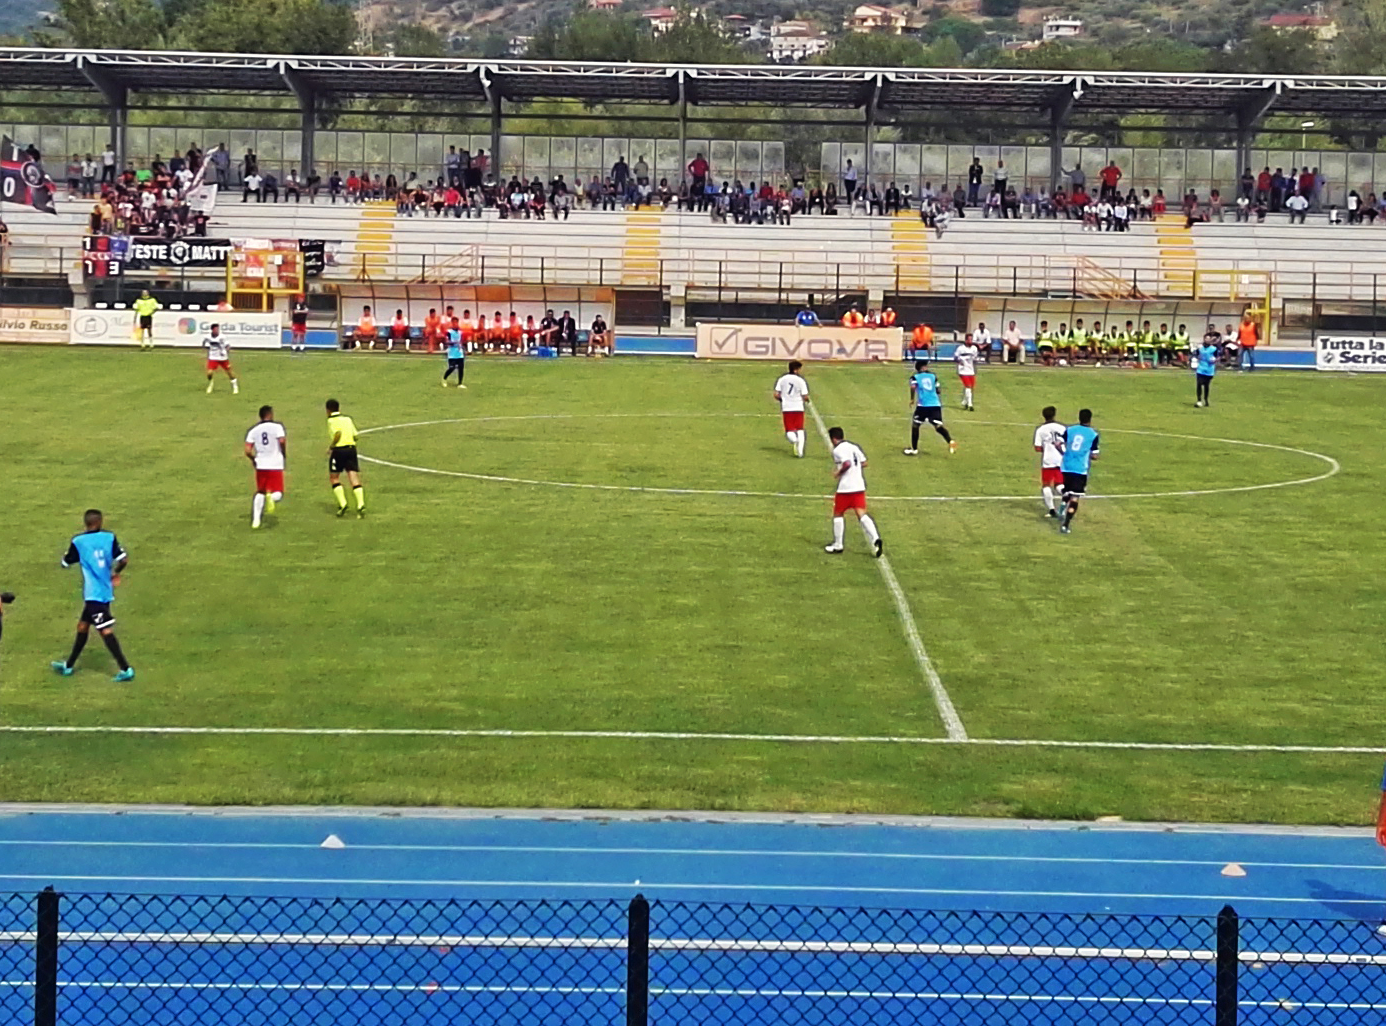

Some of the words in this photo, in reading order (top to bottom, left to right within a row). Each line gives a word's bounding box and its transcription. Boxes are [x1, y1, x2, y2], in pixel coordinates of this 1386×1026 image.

[192, 245, 234, 260] MATT
[110, 261, 120, 275] 3
[29, 320, 69, 331] Russo
[199, 321, 236, 331] Gda
[238, 322, 279, 333] Tourist
[743, 336, 889, 358] GIVOVA
[1320, 338, 1364, 351] Tutta
[1369, 339, 1385, 351] la
[788, 382, 794, 395] 7
[261, 431, 269, 446] 8
[1071, 434, 1084, 452] 8
